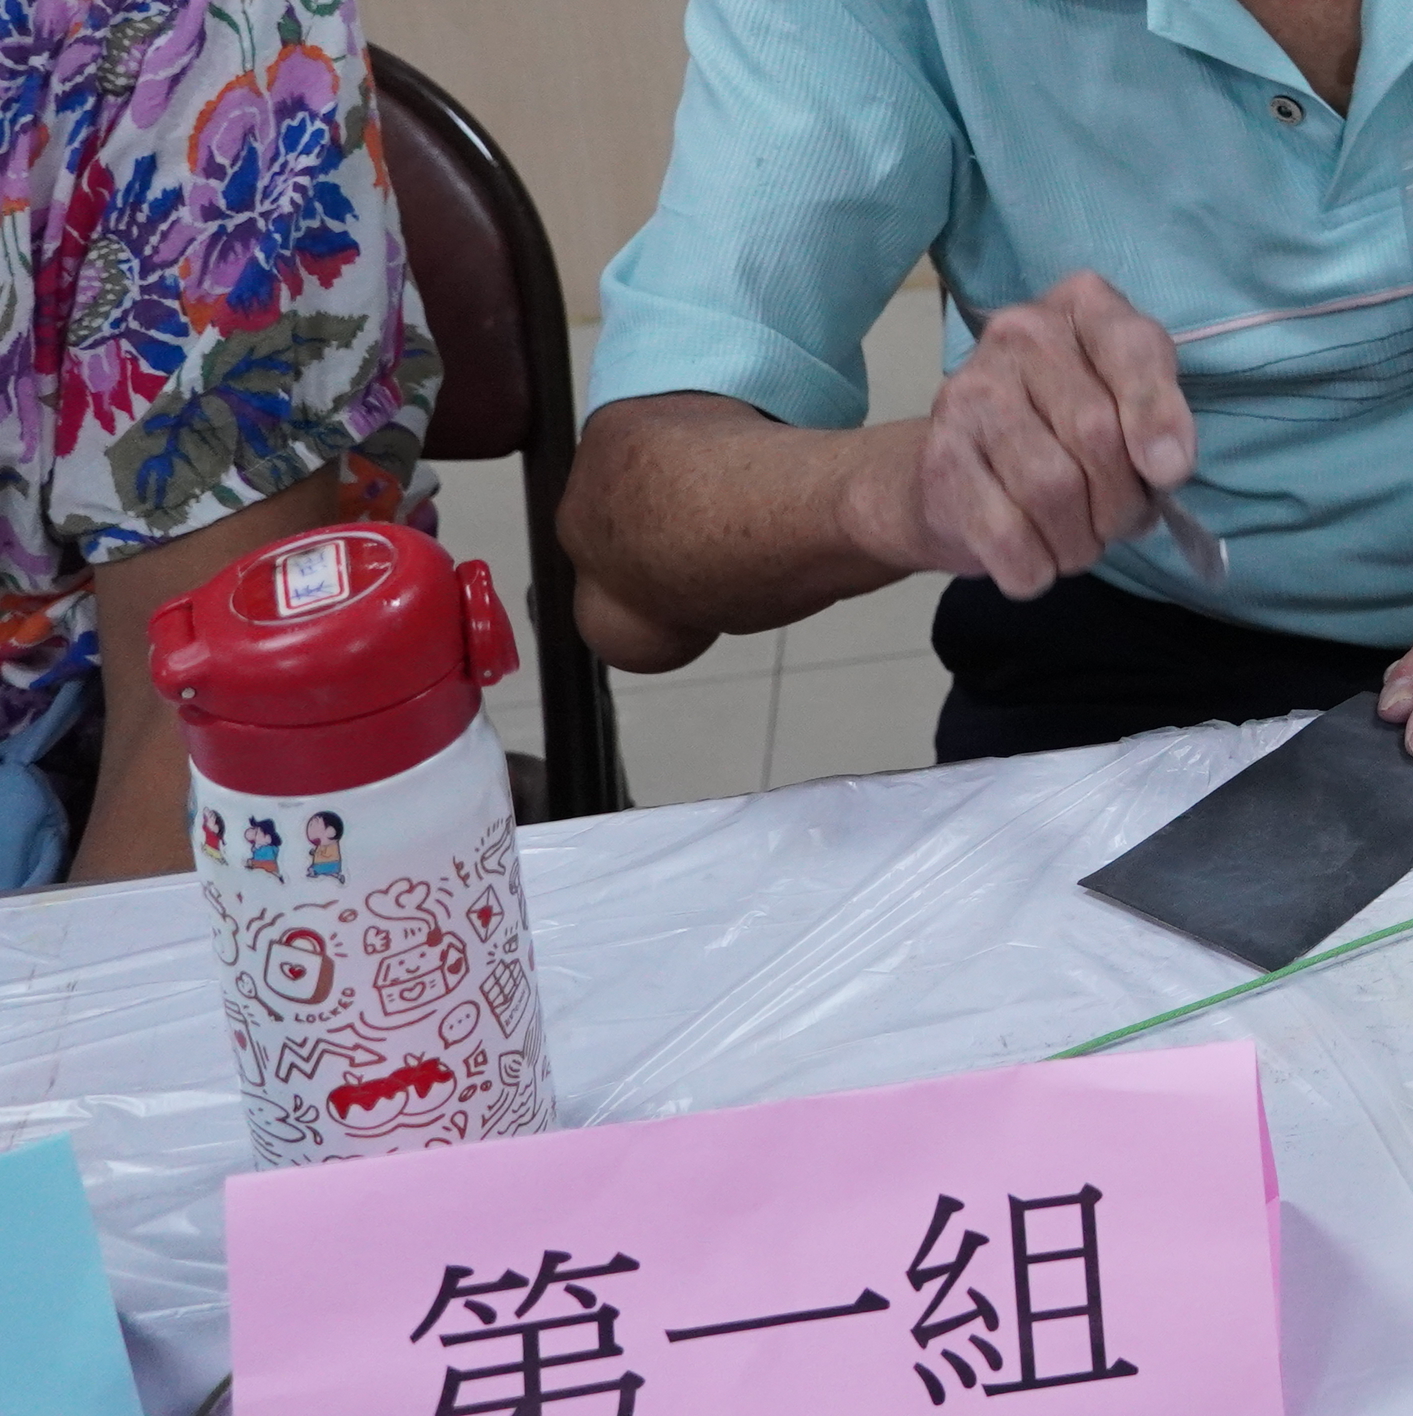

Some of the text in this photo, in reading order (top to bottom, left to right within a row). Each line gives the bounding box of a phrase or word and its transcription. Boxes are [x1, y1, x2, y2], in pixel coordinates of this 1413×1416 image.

[294, 987, 356, 1024] LOCKED
[409, 1183, 1139, 1416] 第一組
